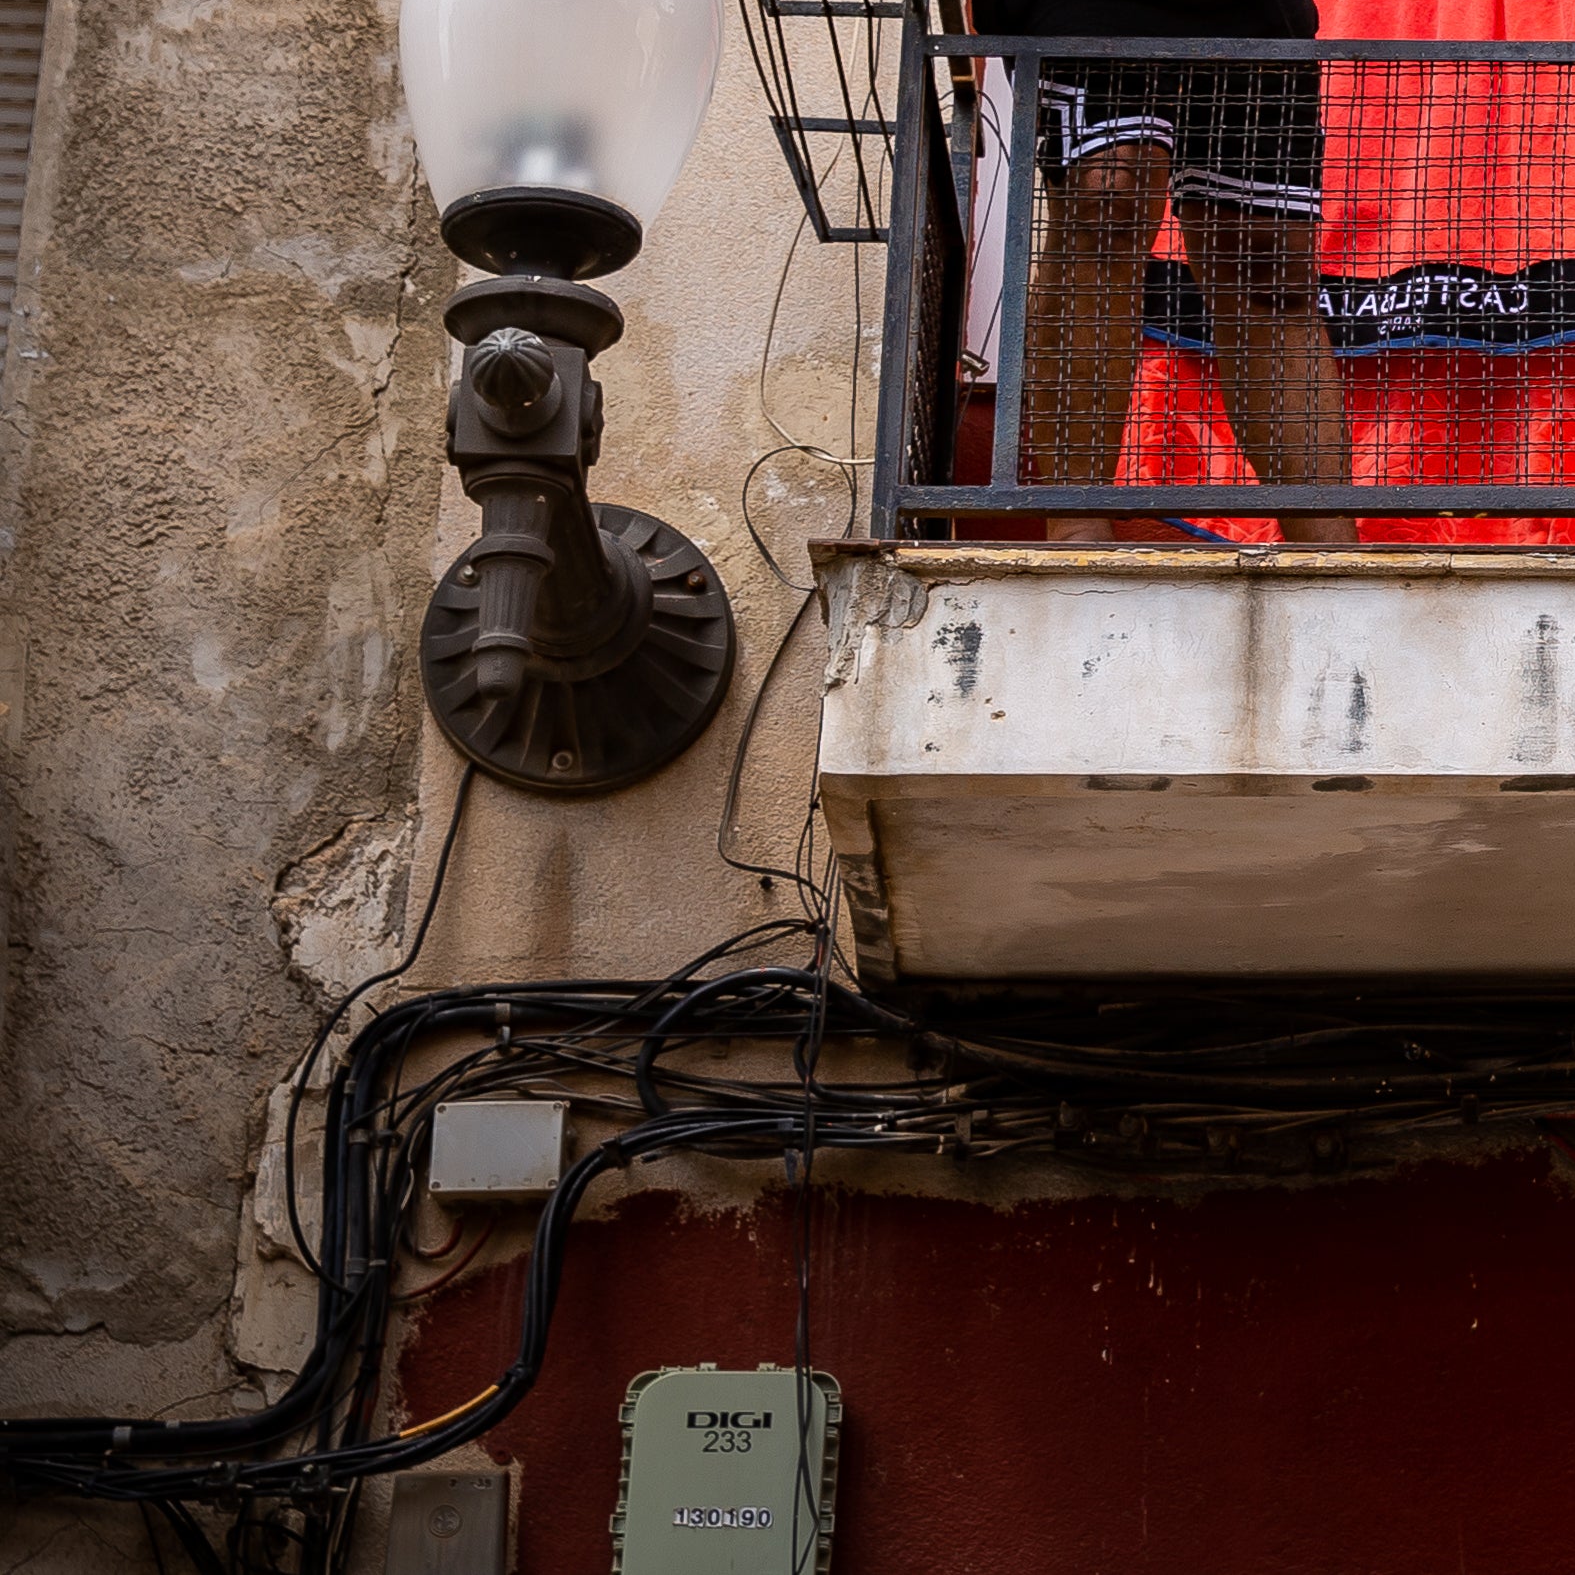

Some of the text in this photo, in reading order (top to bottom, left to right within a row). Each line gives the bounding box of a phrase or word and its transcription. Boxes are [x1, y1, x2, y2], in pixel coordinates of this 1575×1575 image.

[687, 1412, 772, 1429] DIGI
[703, 1430, 752, 1453] 233
[676, 1507, 771, 1528] 130190
